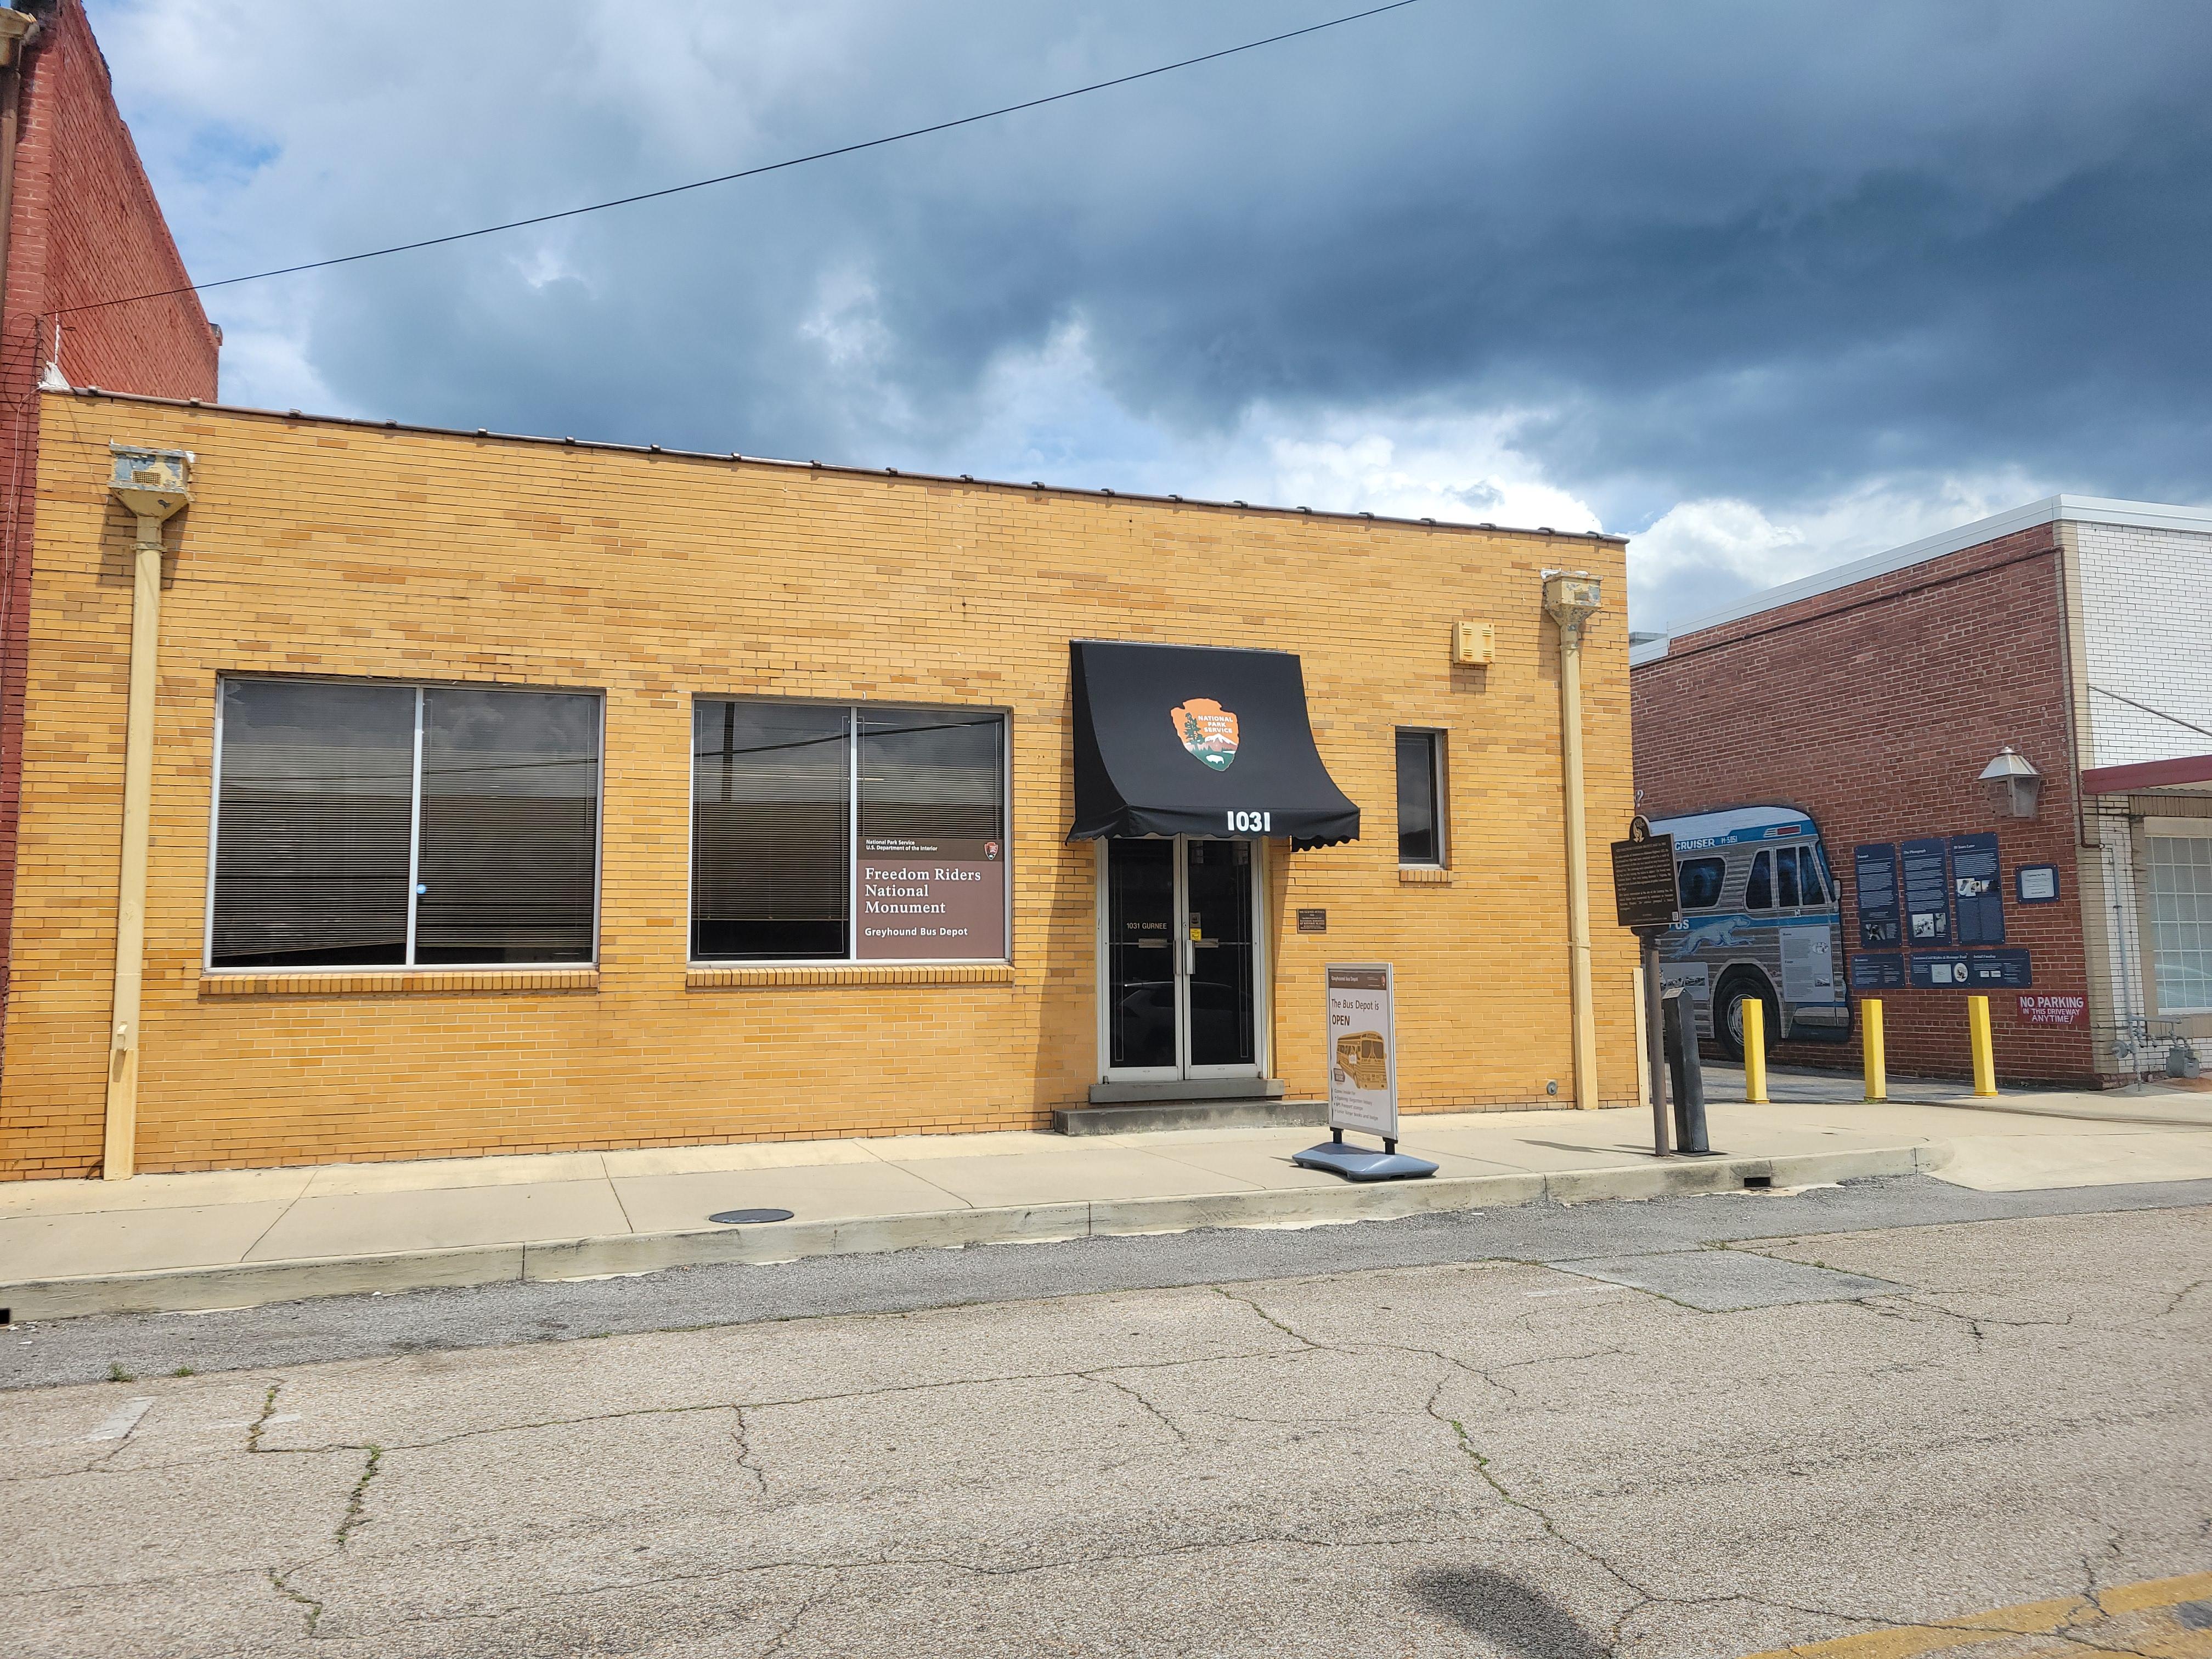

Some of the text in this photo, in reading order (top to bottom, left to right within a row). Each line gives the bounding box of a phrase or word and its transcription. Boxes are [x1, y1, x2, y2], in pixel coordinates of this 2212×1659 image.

[1227, 811, 1271, 832] 1031
[1674, 838, 1716, 850] CRUISER
[865, 867, 981, 881] Freedom Riders
[865, 884, 929, 897] National
[865, 901, 946, 913] Monument
[865, 927, 968, 938] Greyhound Bus Depot
[1331, 998, 1379, 1012] The Bus Depot is
[2019, 996, 2084, 1008] NO PARKING
[1332, 1014, 1350, 1026] OPEN
